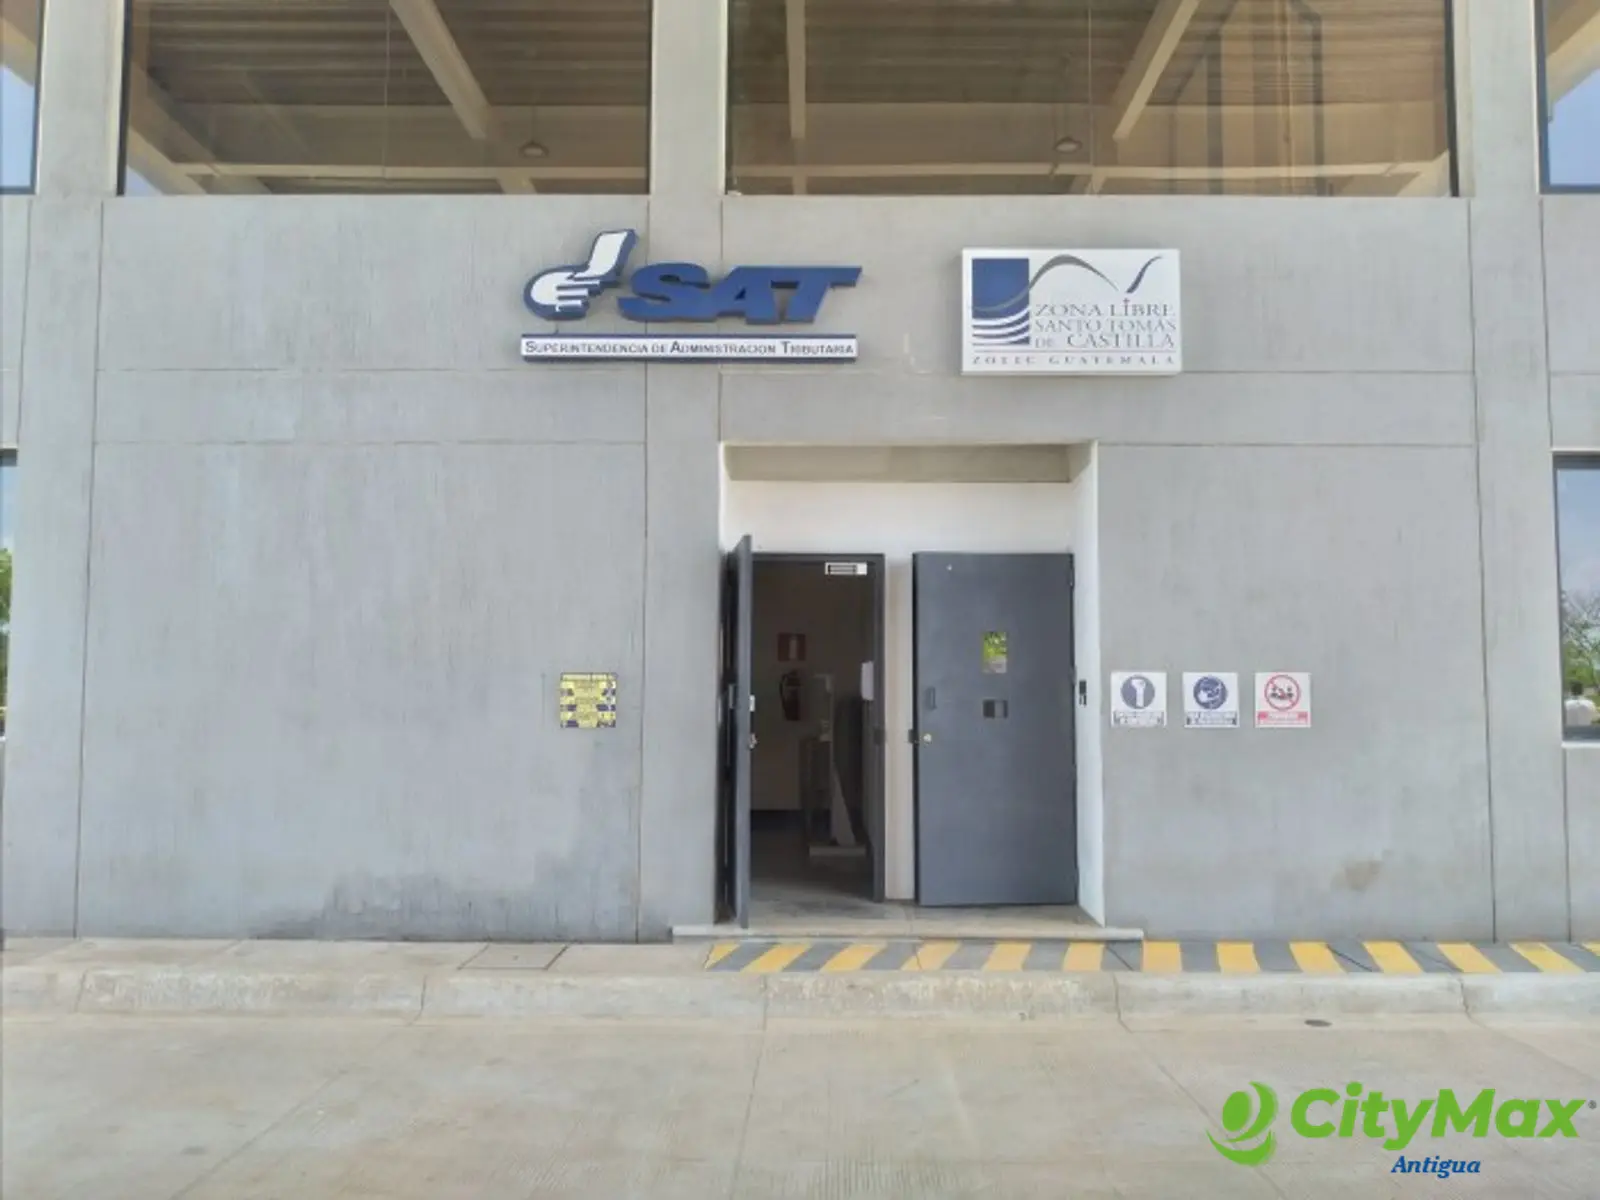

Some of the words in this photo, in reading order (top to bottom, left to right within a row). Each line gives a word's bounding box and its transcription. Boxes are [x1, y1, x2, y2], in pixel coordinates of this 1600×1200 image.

[617, 262, 862, 324] SAT
[1035, 304, 1102, 317] ZONA
[1110, 298, 1176, 317] LIBRE
[1035, 319, 1101, 333] SANTO
[525, 341, 648, 354] SUPERINTENDENCIA
[651, 343, 666, 354] DE
[780, 340, 854, 354] TRIBUTARIA
[1035, 337, 1056, 349] DE
[1067, 333, 1175, 348] CASTILLA
[1049, 356, 1174, 365] GUATEMALA
